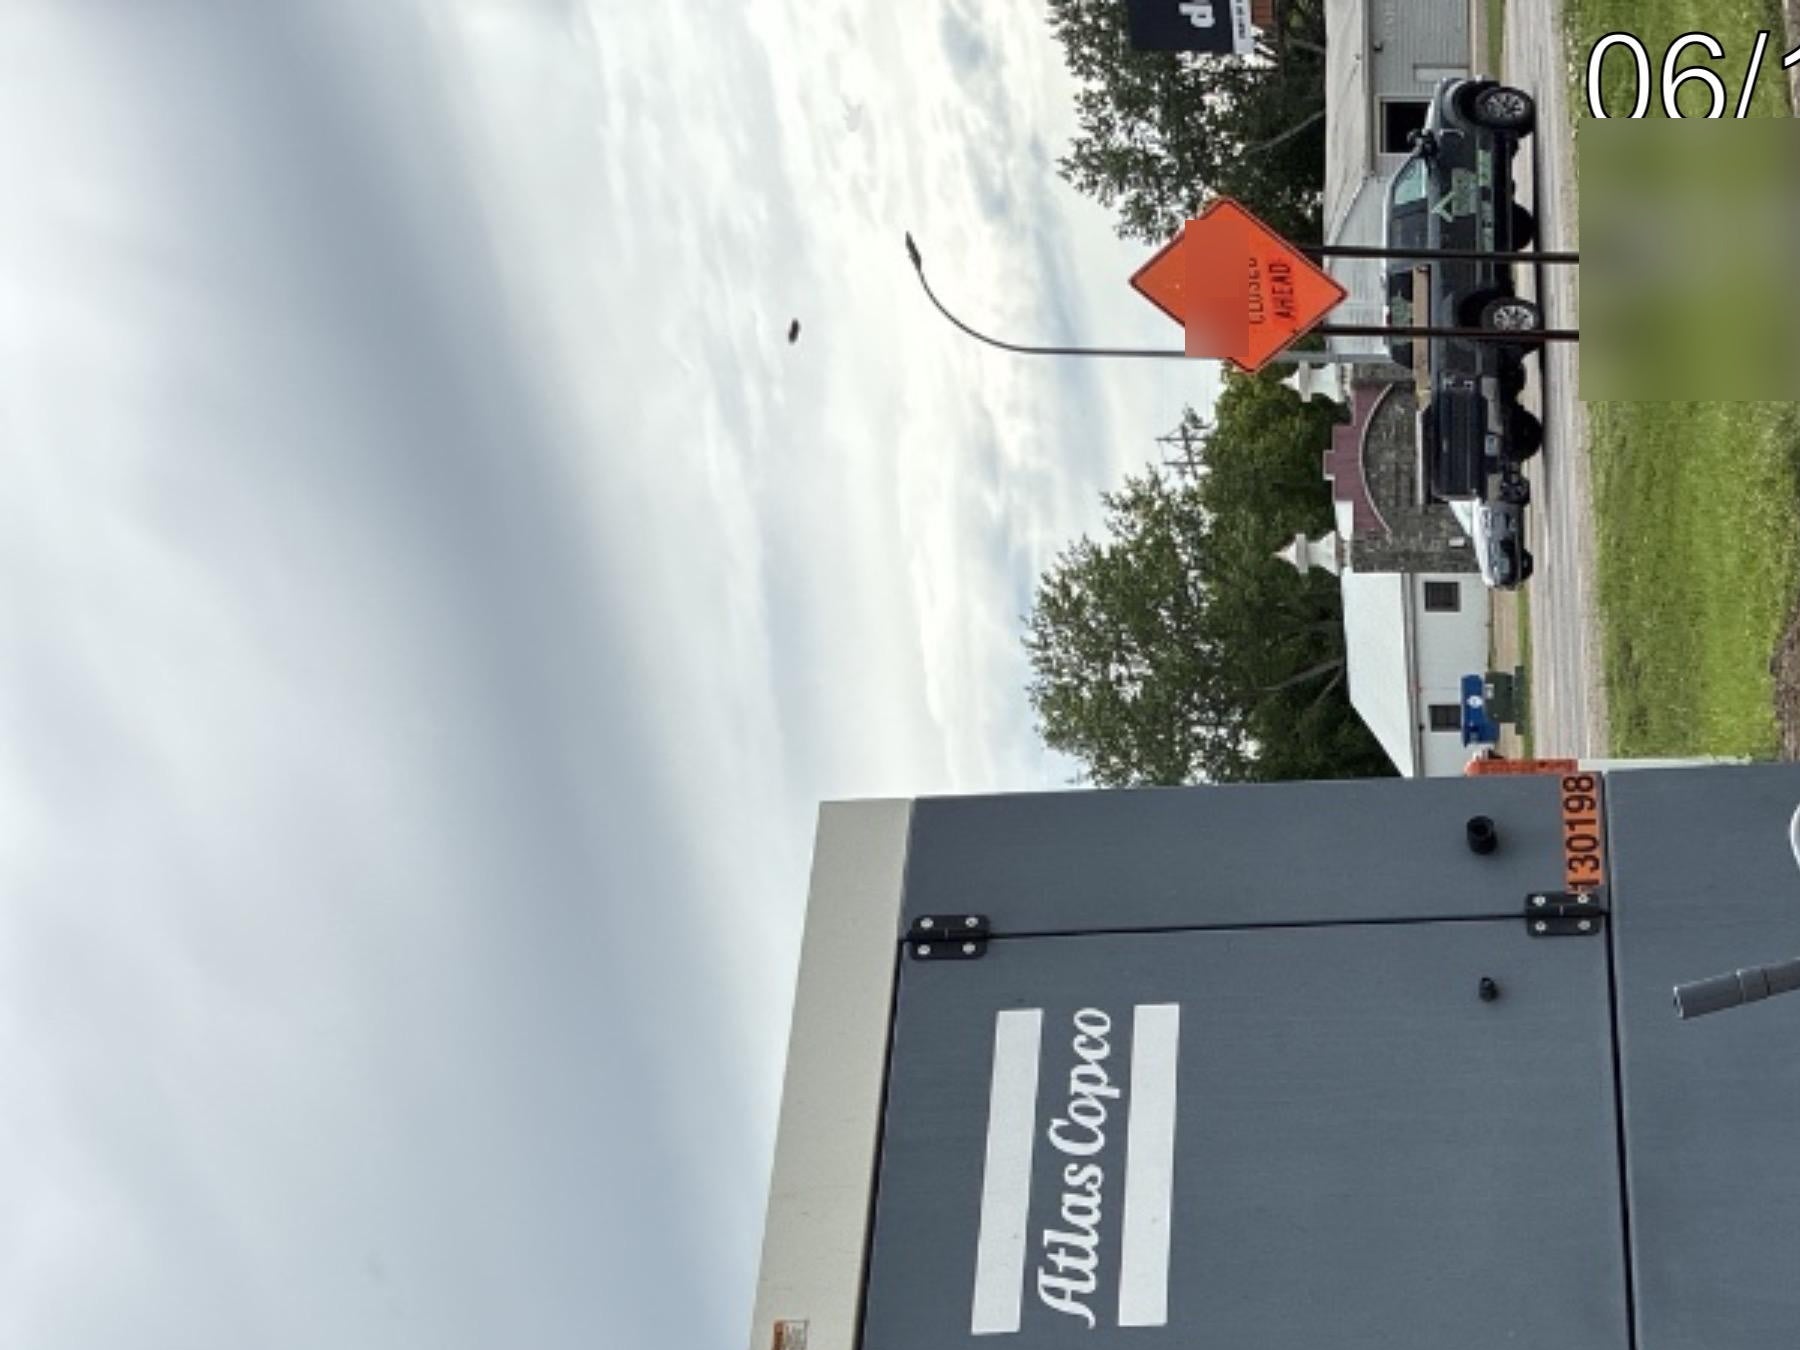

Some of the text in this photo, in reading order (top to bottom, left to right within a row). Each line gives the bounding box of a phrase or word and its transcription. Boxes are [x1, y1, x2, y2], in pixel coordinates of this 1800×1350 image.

[1268, 263, 1295, 319] AHEAD
[1562, 775, 1600, 892] 130198
[1037, 1007, 1120, 1329] Atlas Copco
